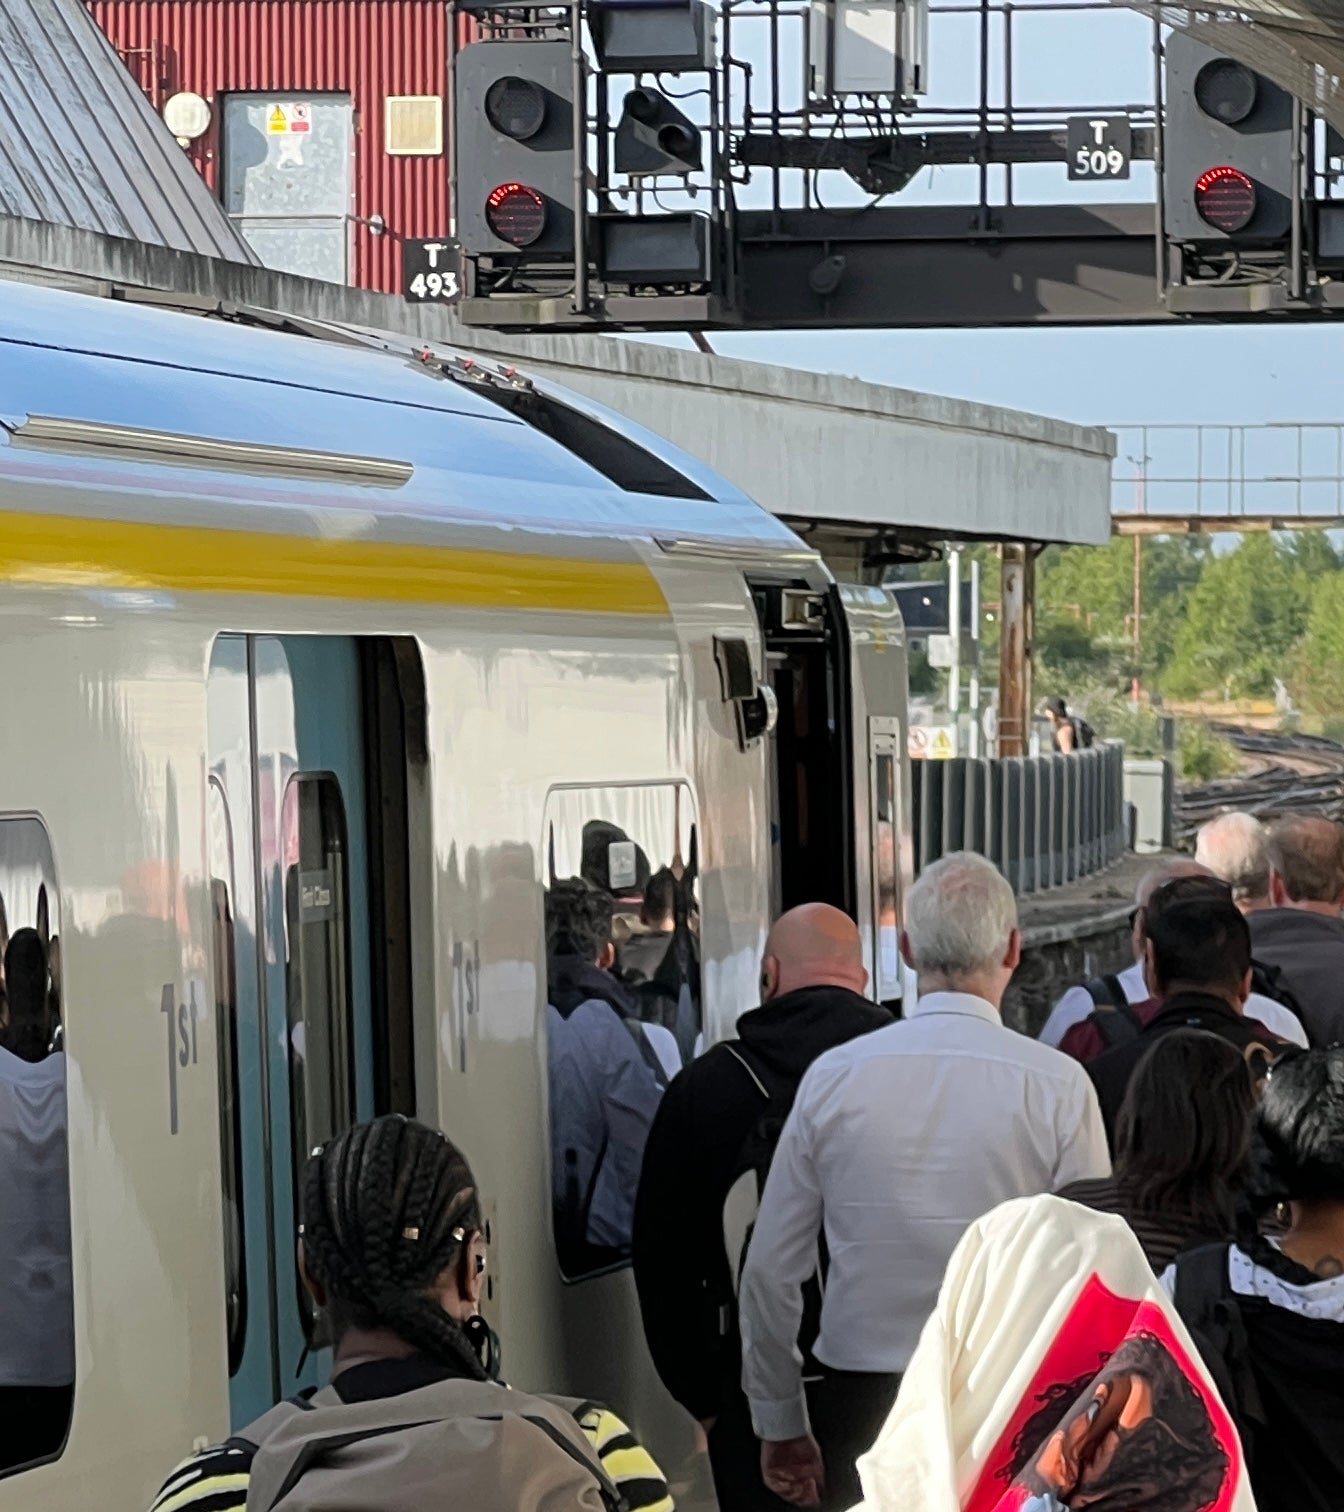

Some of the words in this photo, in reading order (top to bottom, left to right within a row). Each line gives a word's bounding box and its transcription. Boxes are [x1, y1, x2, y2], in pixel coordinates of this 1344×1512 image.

[1089, 120, 1109, 145] T
[1075, 150, 1124, 174] 509
[423, 243, 442, 268] T
[410, 272, 458, 298] 493
[160, 980, 198, 1136] 1st
